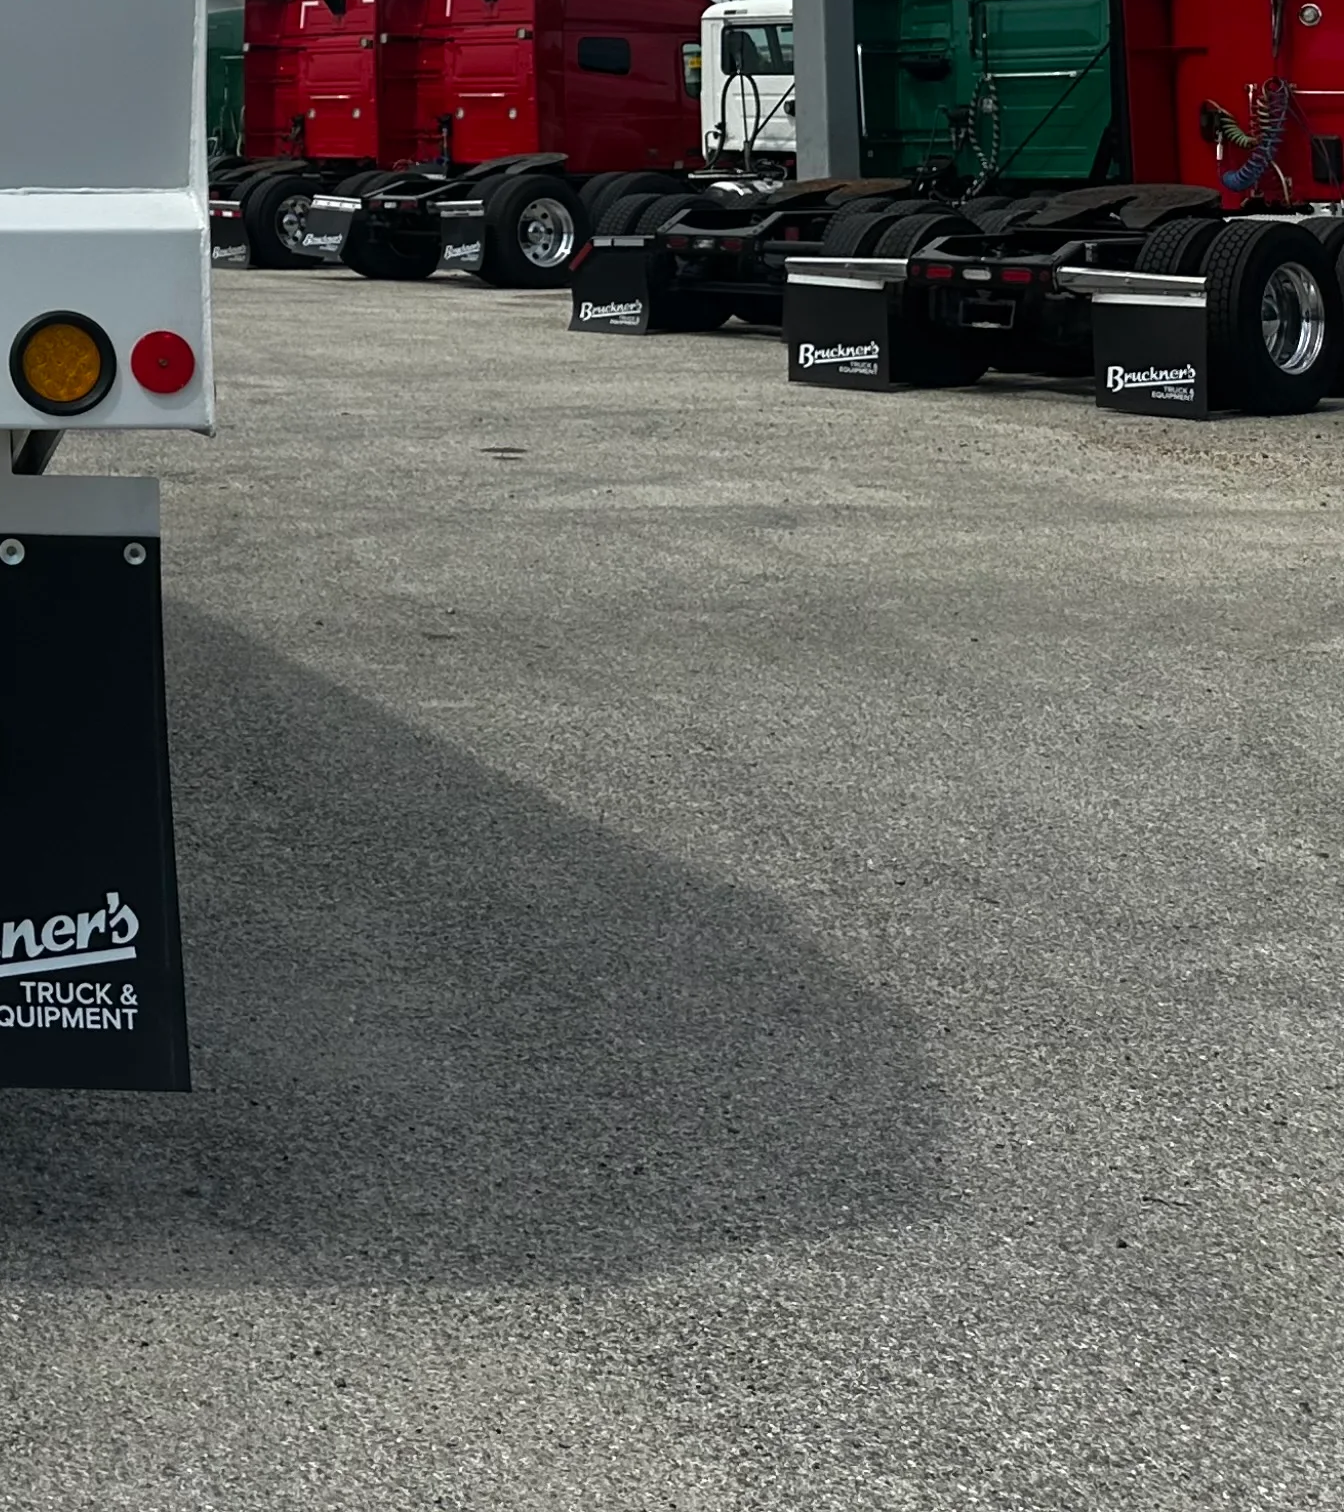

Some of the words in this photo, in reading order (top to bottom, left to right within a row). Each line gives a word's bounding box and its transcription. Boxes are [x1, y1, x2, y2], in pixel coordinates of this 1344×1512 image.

[798, 340, 880, 368] Bruckner's
[1106, 363, 1196, 393] Bruckner's
[1163, 385, 1188, 394] TRUCK
[1151, 390, 1194, 402] EQUIPMENT
[19, 981, 114, 1005] TRUCK
[119, 984, 139, 1006] &
